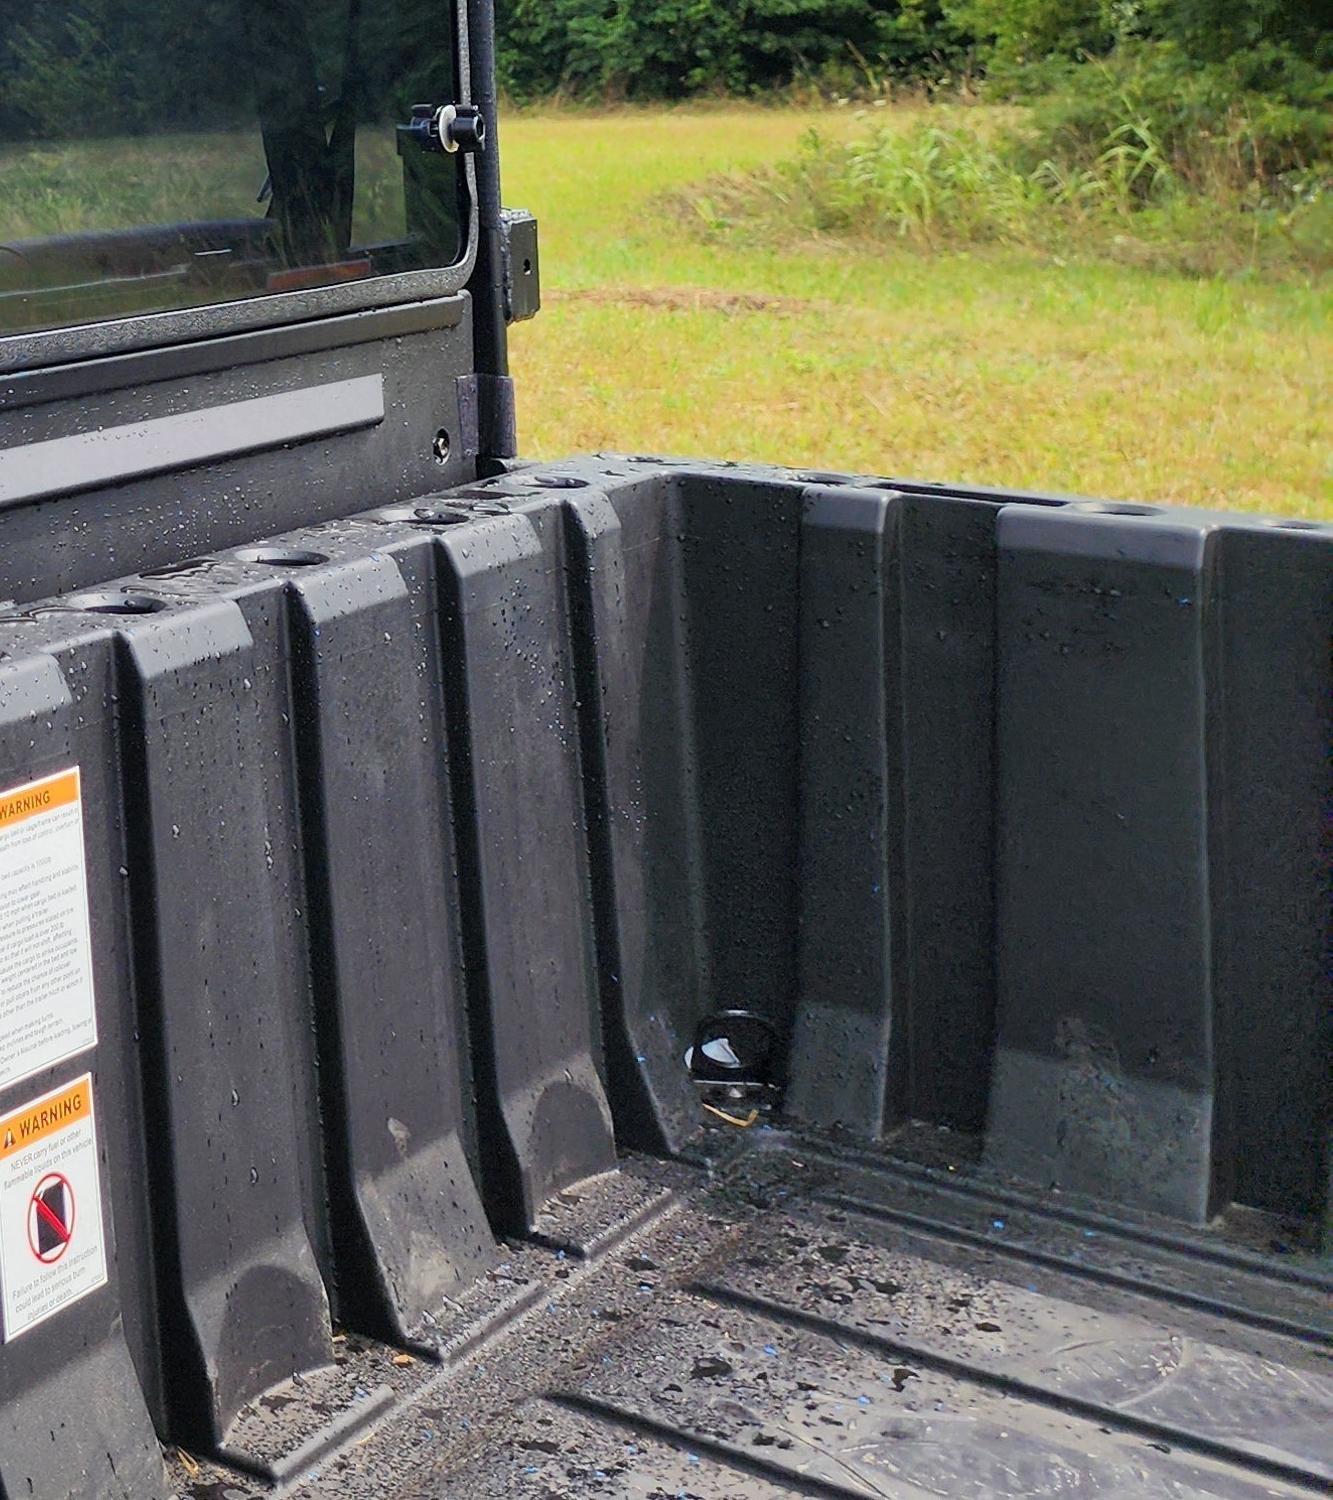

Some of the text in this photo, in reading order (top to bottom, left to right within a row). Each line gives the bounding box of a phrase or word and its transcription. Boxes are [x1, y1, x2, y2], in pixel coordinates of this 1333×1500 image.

[19, 1093, 81, 1139] WARNING
[4, 1166, 33, 1189] flammable
[33, 1157, 52, 1174] liquids
[61, 1147, 71, 1159] this
[11, 1153, 32, 1171] NEVER
[33, 1146, 47, 1161] carry
[48, 1139, 58, 1153] fuel
[66, 1128, 81, 1142] other
[12, 1281, 32, 1299] Failure
[40, 1267, 56, 1284] follow
[57, 1260, 67, 1274] this
[68, 1243, 97, 1267] instruction
[15, 1296, 30, 1313] could
[31, 1289, 43, 1303] lead
[51, 1273, 71, 1291] serious
